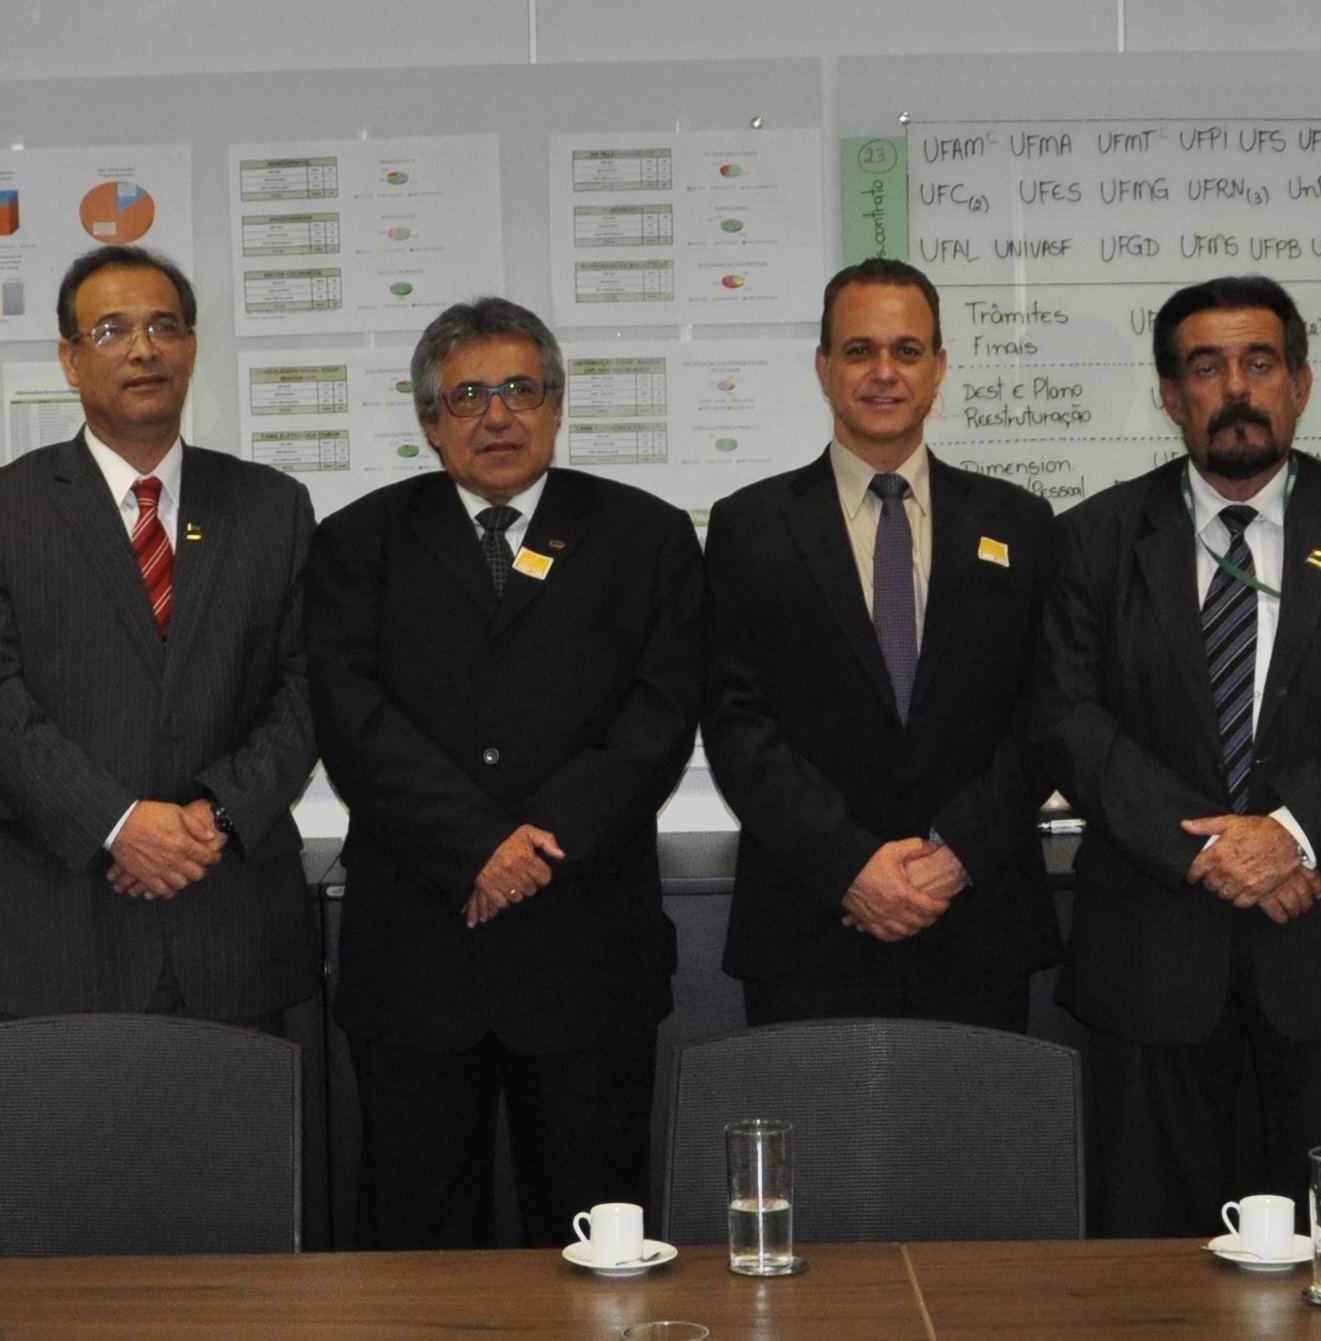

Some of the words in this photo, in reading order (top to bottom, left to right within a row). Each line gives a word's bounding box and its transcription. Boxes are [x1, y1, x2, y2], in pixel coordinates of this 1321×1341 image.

[923, 134, 984, 163] UFAM
[1010, 132, 1072, 157] UFMA
[1097, 129, 1157, 154] UFMT
[1239, 127, 1287, 152] UFS
[1019, 179, 1082, 204] UFES
[1100, 177, 1170, 205] UFMG
[920, 237, 981, 264] UFAL
[1100, 234, 1161, 263] UFGD
[1180, 232, 1239, 260] UFMS
[1250, 236, 1302, 261] UFPB
[965, 300, 1069, 325] Trâmites
[974, 335, 1039, 356] Finais
[1032, 376, 1083, 400] Plano
